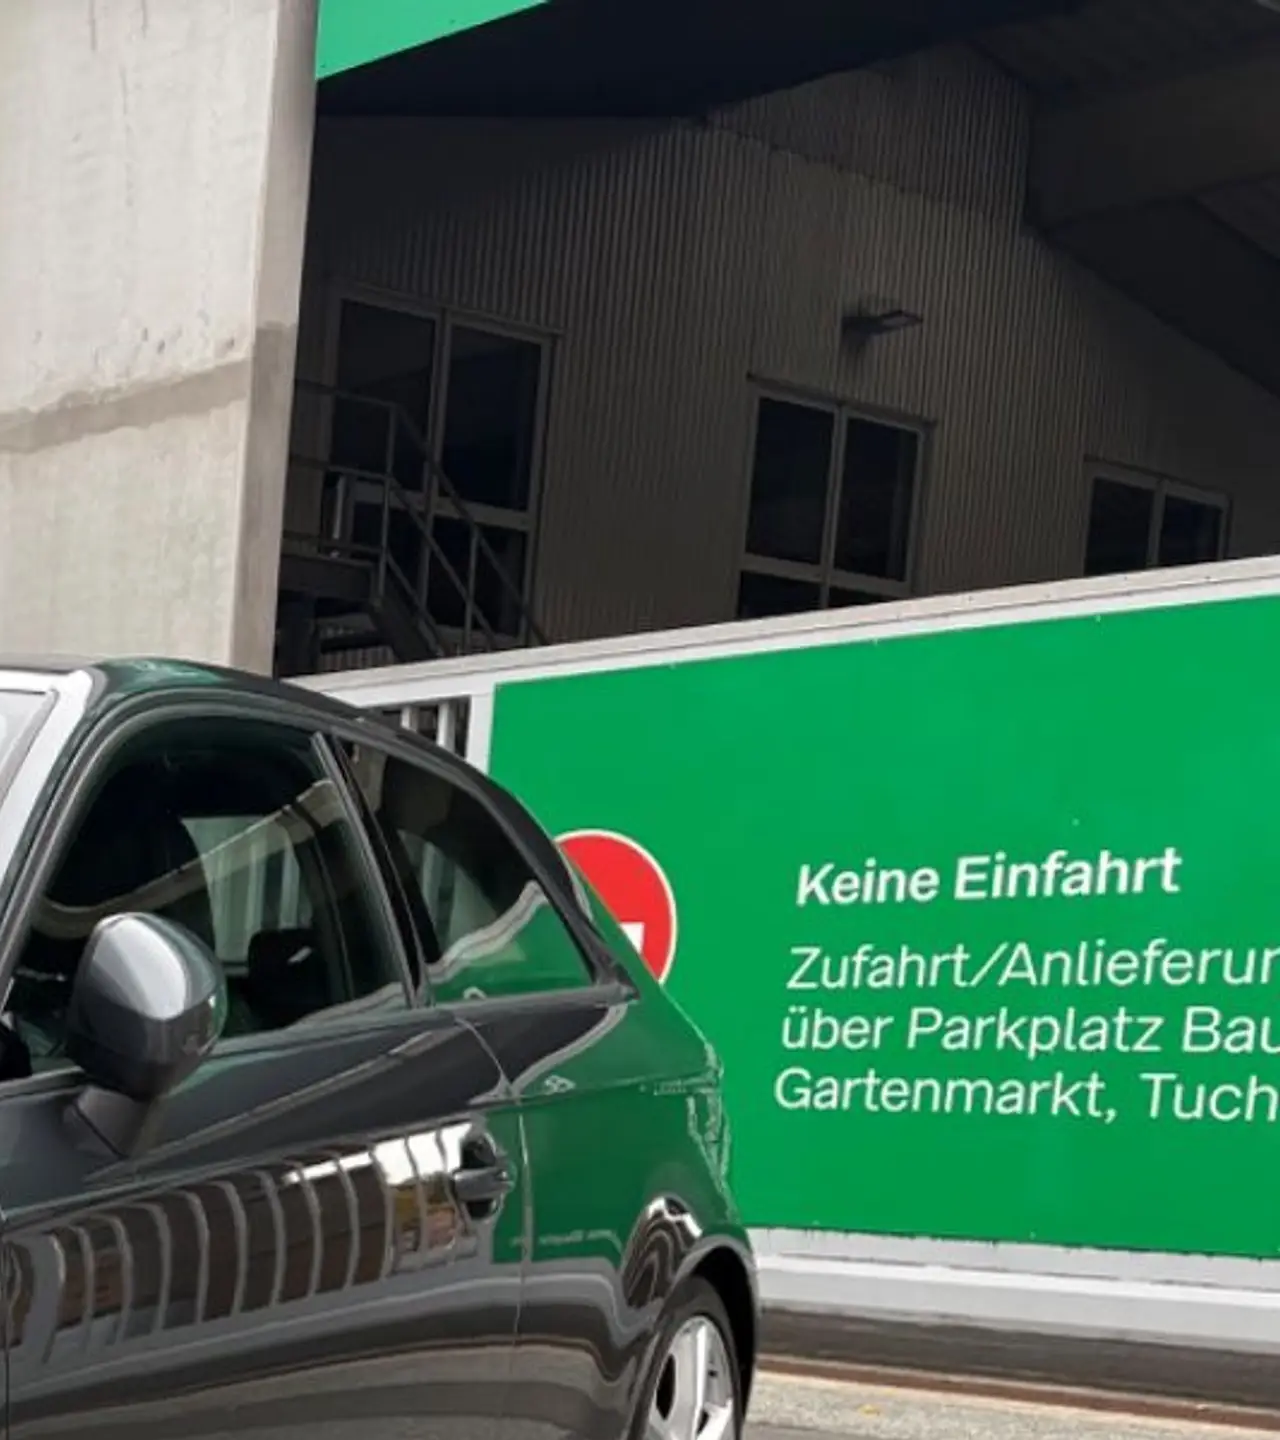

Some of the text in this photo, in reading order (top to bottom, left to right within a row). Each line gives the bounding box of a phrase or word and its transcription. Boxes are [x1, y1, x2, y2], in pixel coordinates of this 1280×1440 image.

[796, 848, 1182, 907] Keine Einfahrt
[781, 1005, 1280, 1060] über Parkplatz Bau
[774, 1066, 1279, 1124] Gartenmarkt, Tuch
